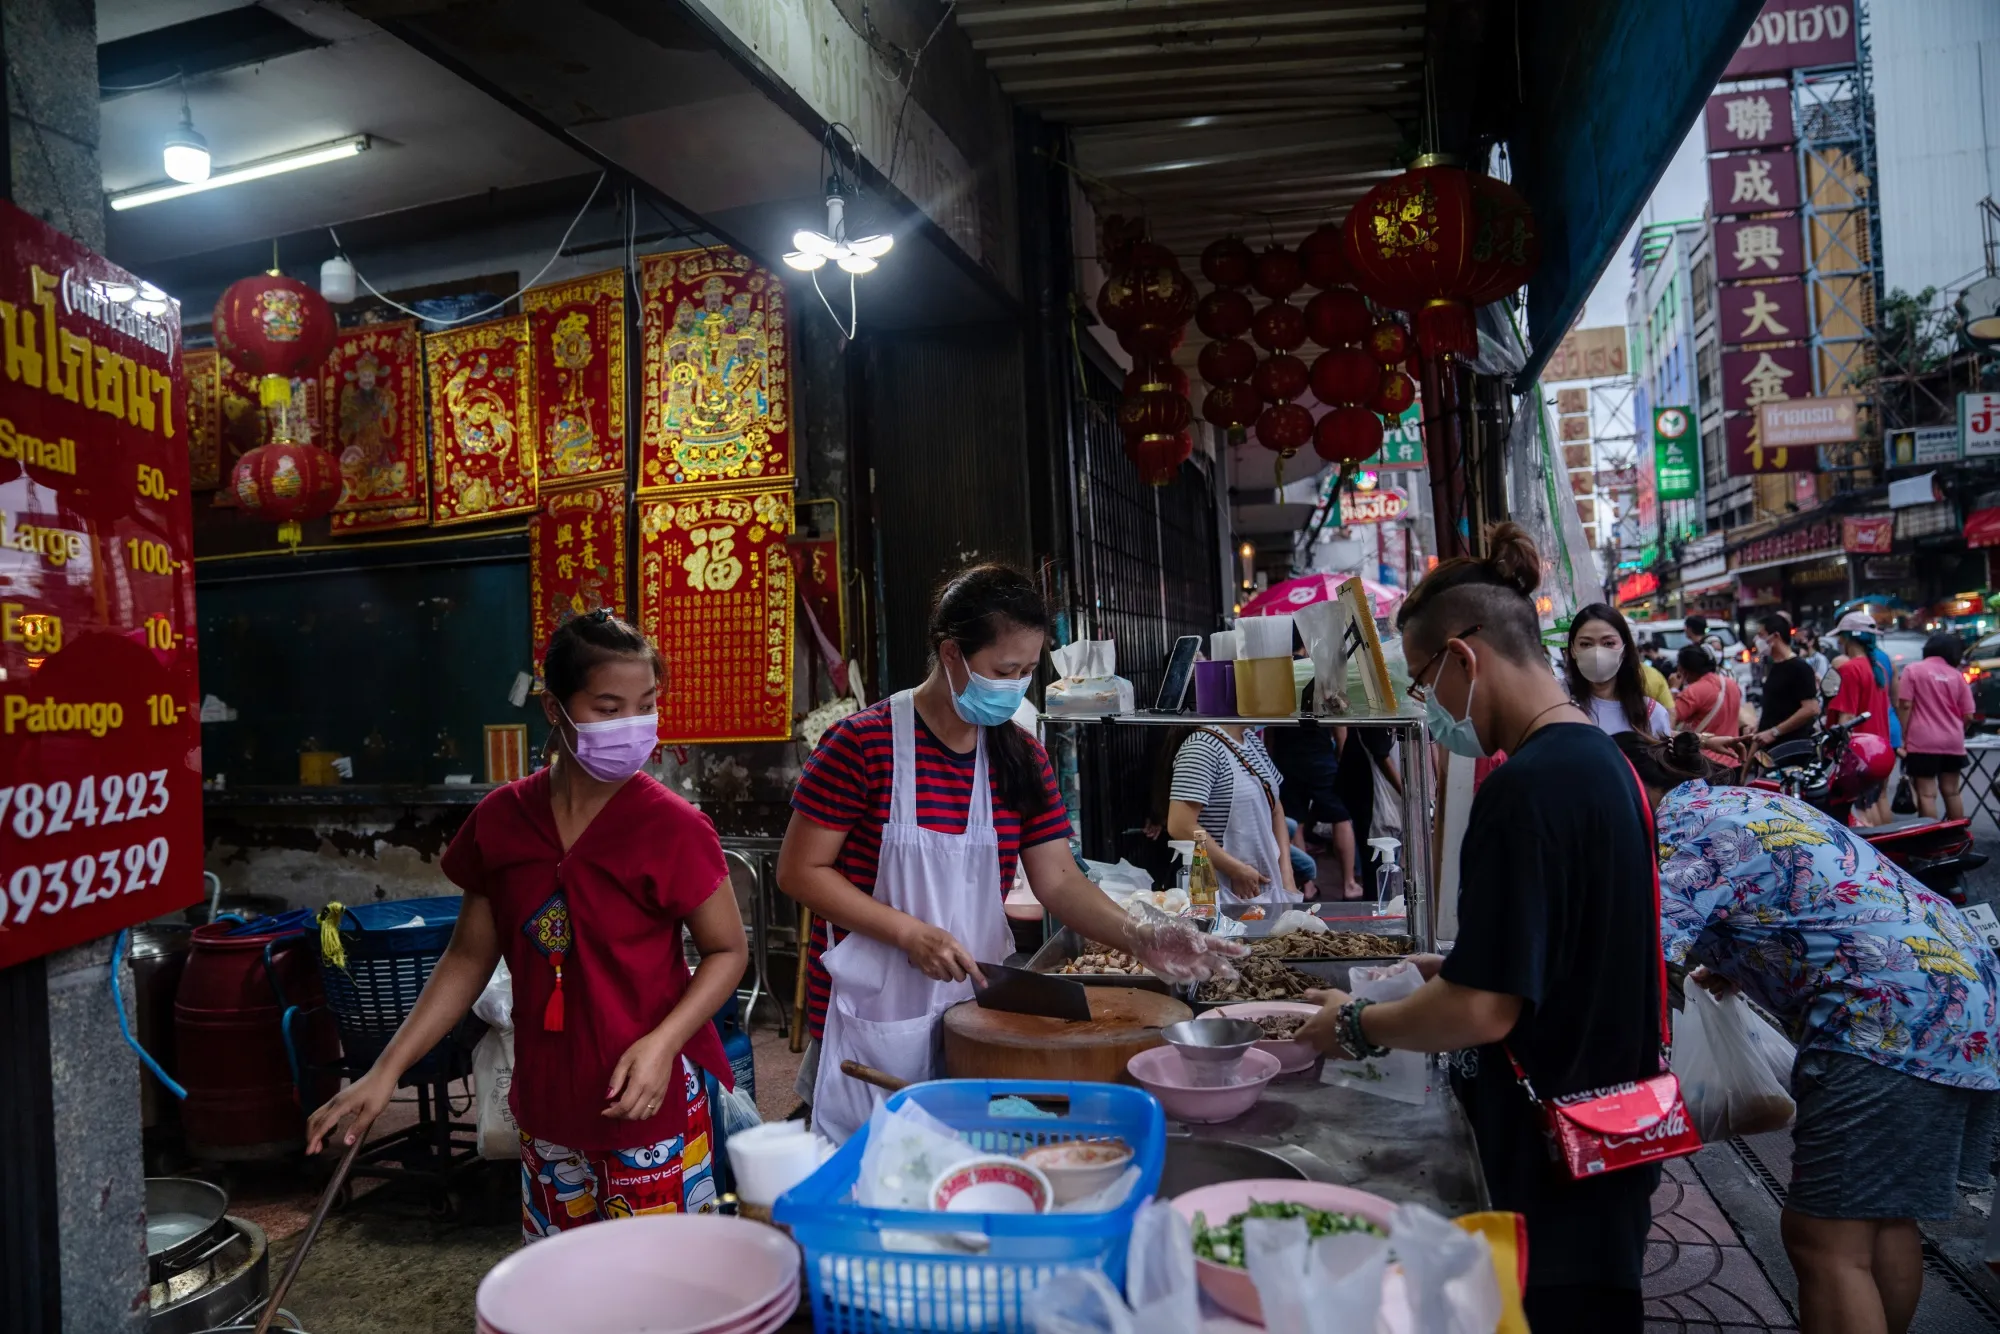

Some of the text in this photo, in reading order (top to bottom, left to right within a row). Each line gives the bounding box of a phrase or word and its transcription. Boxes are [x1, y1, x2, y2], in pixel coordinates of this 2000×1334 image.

[0, 418, 76, 475] Small
[0, 508, 82, 566] Large
[683, 524, 743, 592] 福
[2, 603, 62, 654] Egg
[4, 694, 123, 737] Patongo
[0, 836, 170, 928] 932329
